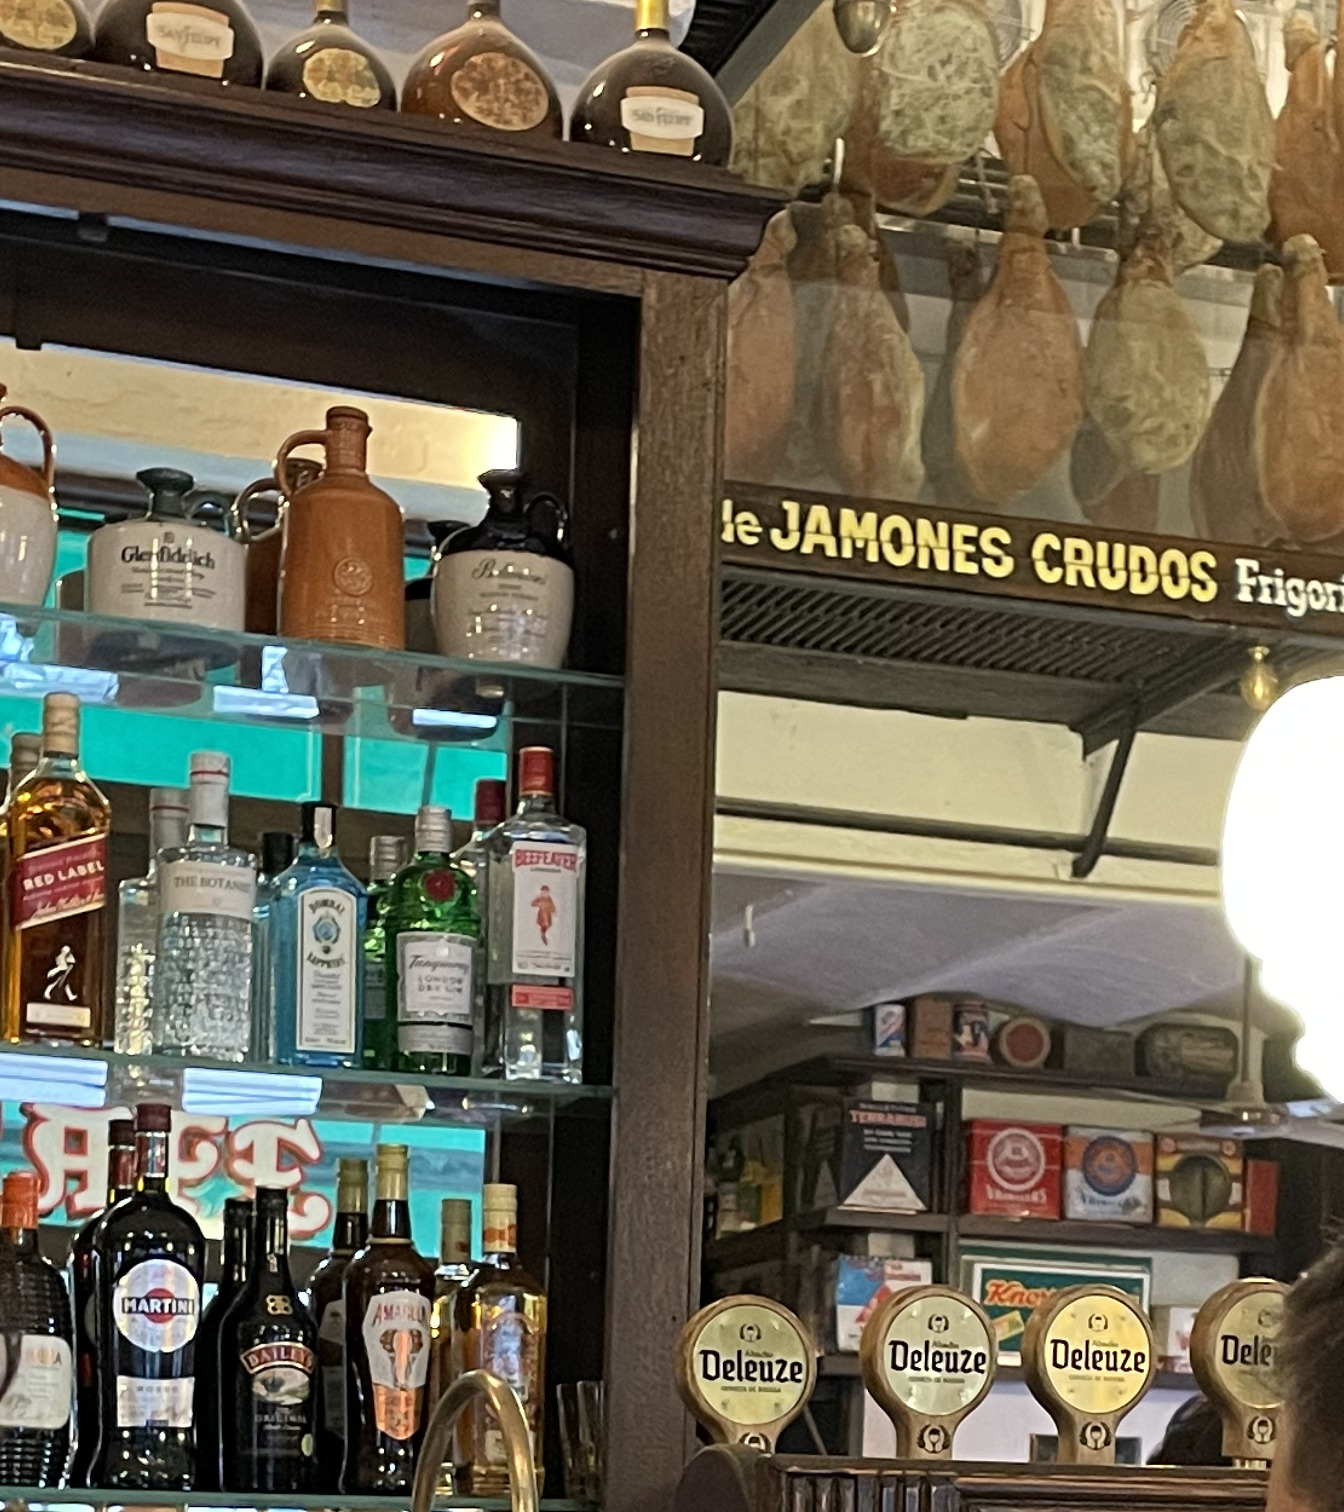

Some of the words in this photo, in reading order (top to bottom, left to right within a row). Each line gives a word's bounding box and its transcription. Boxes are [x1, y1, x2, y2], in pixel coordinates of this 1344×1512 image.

[769, 500, 1016, 579] JAMONES
[1031, 532, 1218, 603] CRUDOS
[23, 873, 55, 891] RED
[57, 860, 105, 882] LABEL
[173, 875, 198, 889] THE
[123, 1297, 194, 1315] MARTINI
[698, 1349, 804, 1384] Deleuze
[887, 1339, 987, 1375] Deleuze
[1050, 1338, 1147, 1374] Deleuze
[1220, 1334, 1278, 1368] Dele
